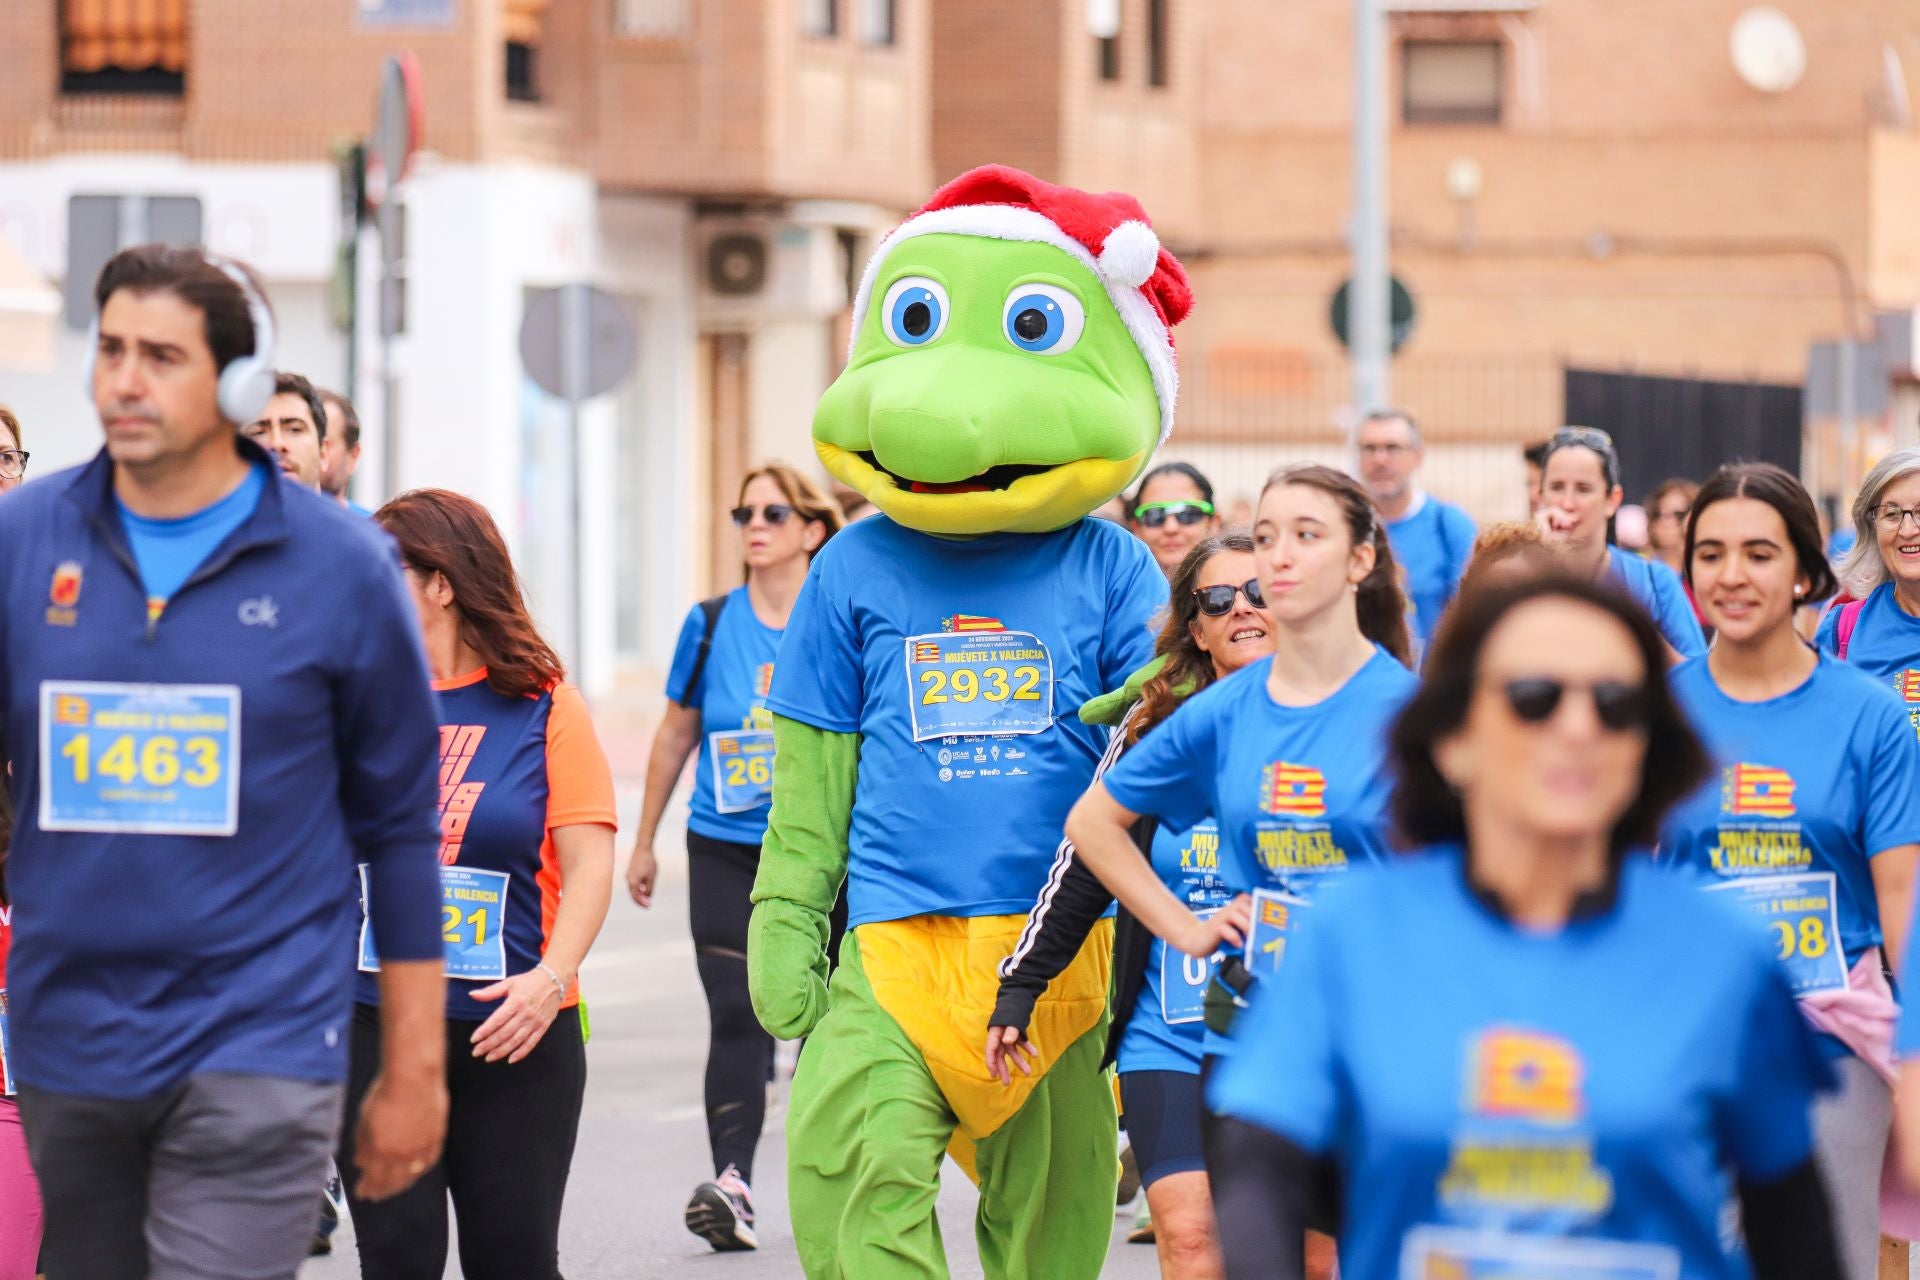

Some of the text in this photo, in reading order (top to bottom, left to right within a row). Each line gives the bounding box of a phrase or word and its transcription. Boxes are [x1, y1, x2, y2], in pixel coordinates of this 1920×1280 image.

[944, 649, 1045, 663] MUÉVETE X VALENCIA
[919, 666, 1041, 705] 2932
[61, 731, 222, 788] 1463
[725, 756, 774, 787] 26
[1257, 828, 1333, 851] MUÉVETE
[1718, 829, 1801, 850] MUÉVETE
[1179, 849, 1192, 867] X
[1265, 848, 1346, 868] VALENCIA
[1709, 847, 1812, 868] X VALENCIA
[444, 887, 499, 904] X VALENCIA
[441, 906, 488, 946] 21
